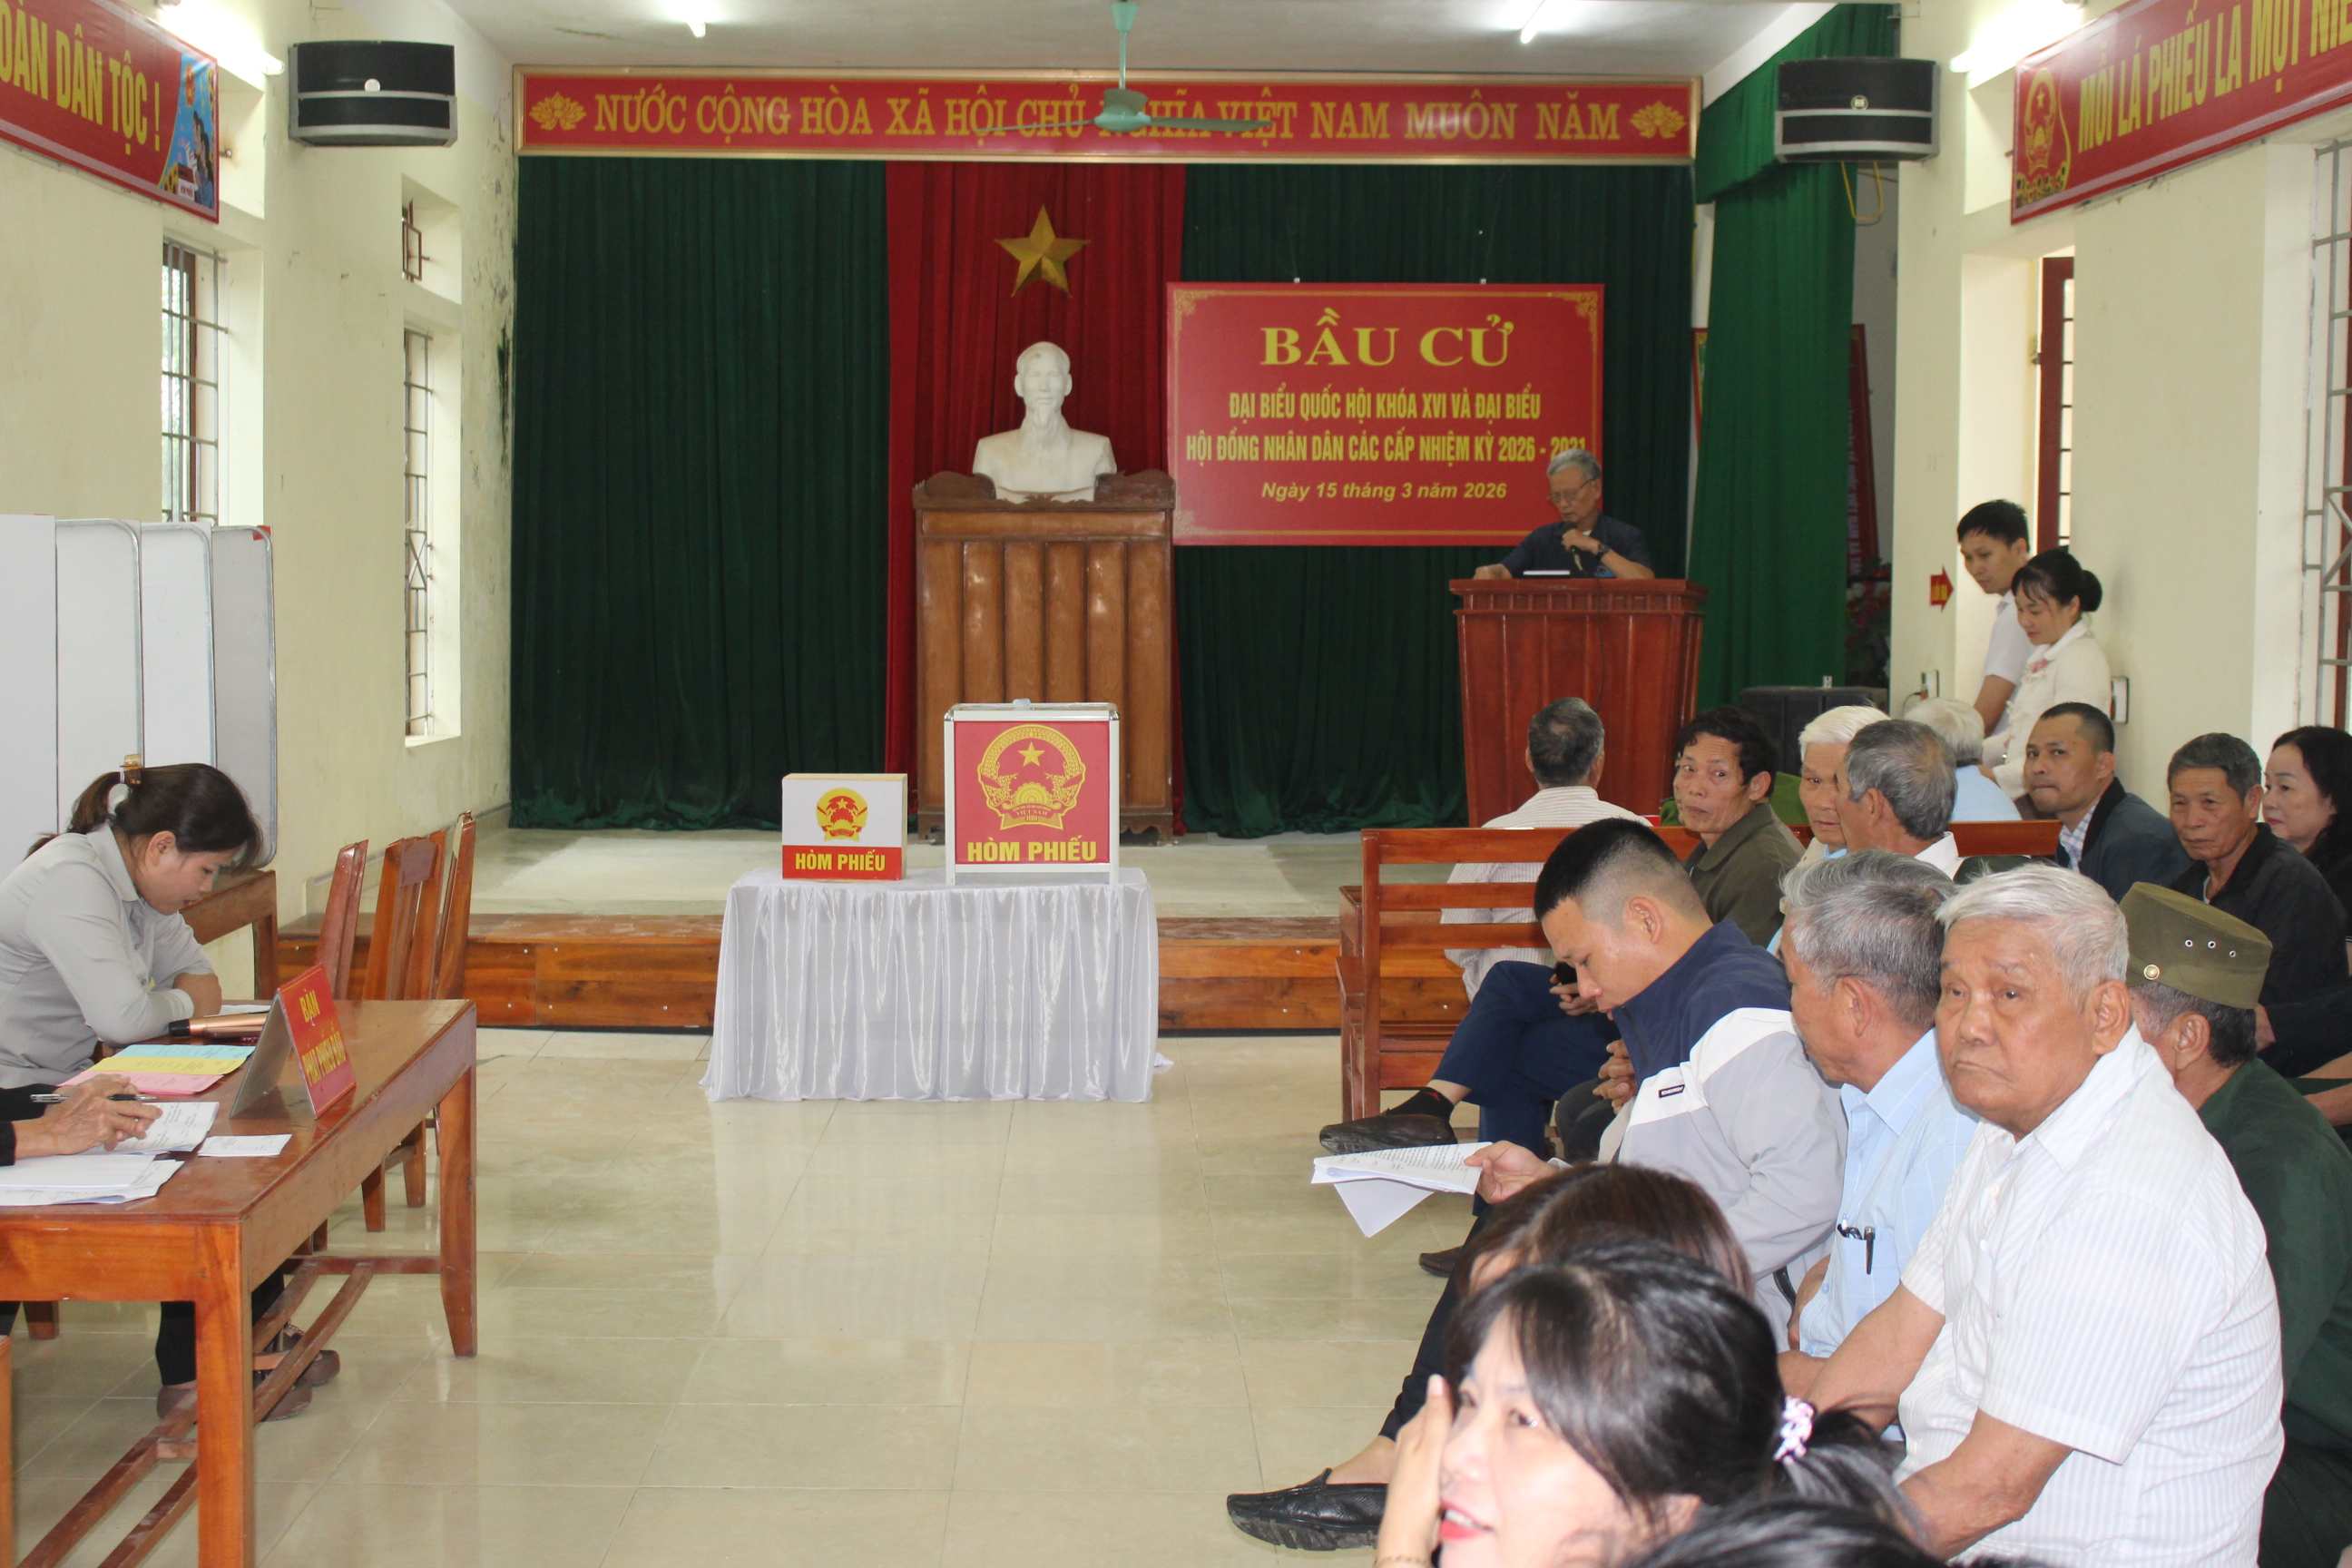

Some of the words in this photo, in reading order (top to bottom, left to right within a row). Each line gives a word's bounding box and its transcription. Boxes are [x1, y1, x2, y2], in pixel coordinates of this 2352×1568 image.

[56, 23, 103, 125] DÂN
[109, 49, 148, 155] TỘC
[2078, 40, 2114, 153] MỖI
[2118, 34, 2141, 137] LÁ
[2146, 0, 2210, 125] PHIẾU
[594, 83, 686, 133] NƯỚC
[697, 83, 791, 144] CỘNG
[799, 83, 873, 135] HÒA
[886, 87, 936, 135] XÃ
[945, 83, 1006, 147] HỘI
[1016, 83, 1086, 138] CHỦ
[1099, 88, 1211, 137] HĨA
[1217, 87, 1298, 147] VIỆT
[1310, 102, 1390, 138] NAM
[1405, 89, 1518, 140] MUÔN
[1536, 90, 1621, 140] NĂM
[1260, 308, 1399, 366] BẦU
[1420, 314, 1514, 367] CỬ
[1230, 392, 1256, 424] ĐẠI
[1260, 382, 1295, 418] BIỂU
[1300, 384, 1341, 421] QUỐC
[1346, 387, 1372, 424] HỘI
[1376, 387, 1417, 418] KHÓA
[1422, 393, 1446, 418] XVI
[1452, 387, 1471, 418] VÀ
[1475, 393, 1501, 425] ĐẠI
[1505, 383, 1541, 419] BIỂU
[1186, 430, 1212, 466] HỘI
[1217, 426, 1259, 461] ĐỒNG
[1264, 430, 1308, 461] NHÂN
[1312, 430, 1344, 461] DÂN
[1348, 430, 1379, 461] CÁC
[1384, 426, 1415, 461] CẤP
[1419, 430, 1470, 466] NHIỆM
[1475, 430, 1494, 461] KỲ
[1498, 436, 1535, 462] 2026
[1261, 482, 1310, 502] Ngày
[1317, 483, 1338, 498] 15
[1343, 482, 1396, 502] tháng
[1401, 483, 1413, 498] 3
[1417, 482, 1458, 498] năm
[1464, 483, 1507, 499] 2026
[795, 849, 832, 870] HÒM
[838, 849, 886, 871] PHIẾU
[967, 837, 1020, 862] HÒM
[1028, 835, 1097, 862] PHIẾU
